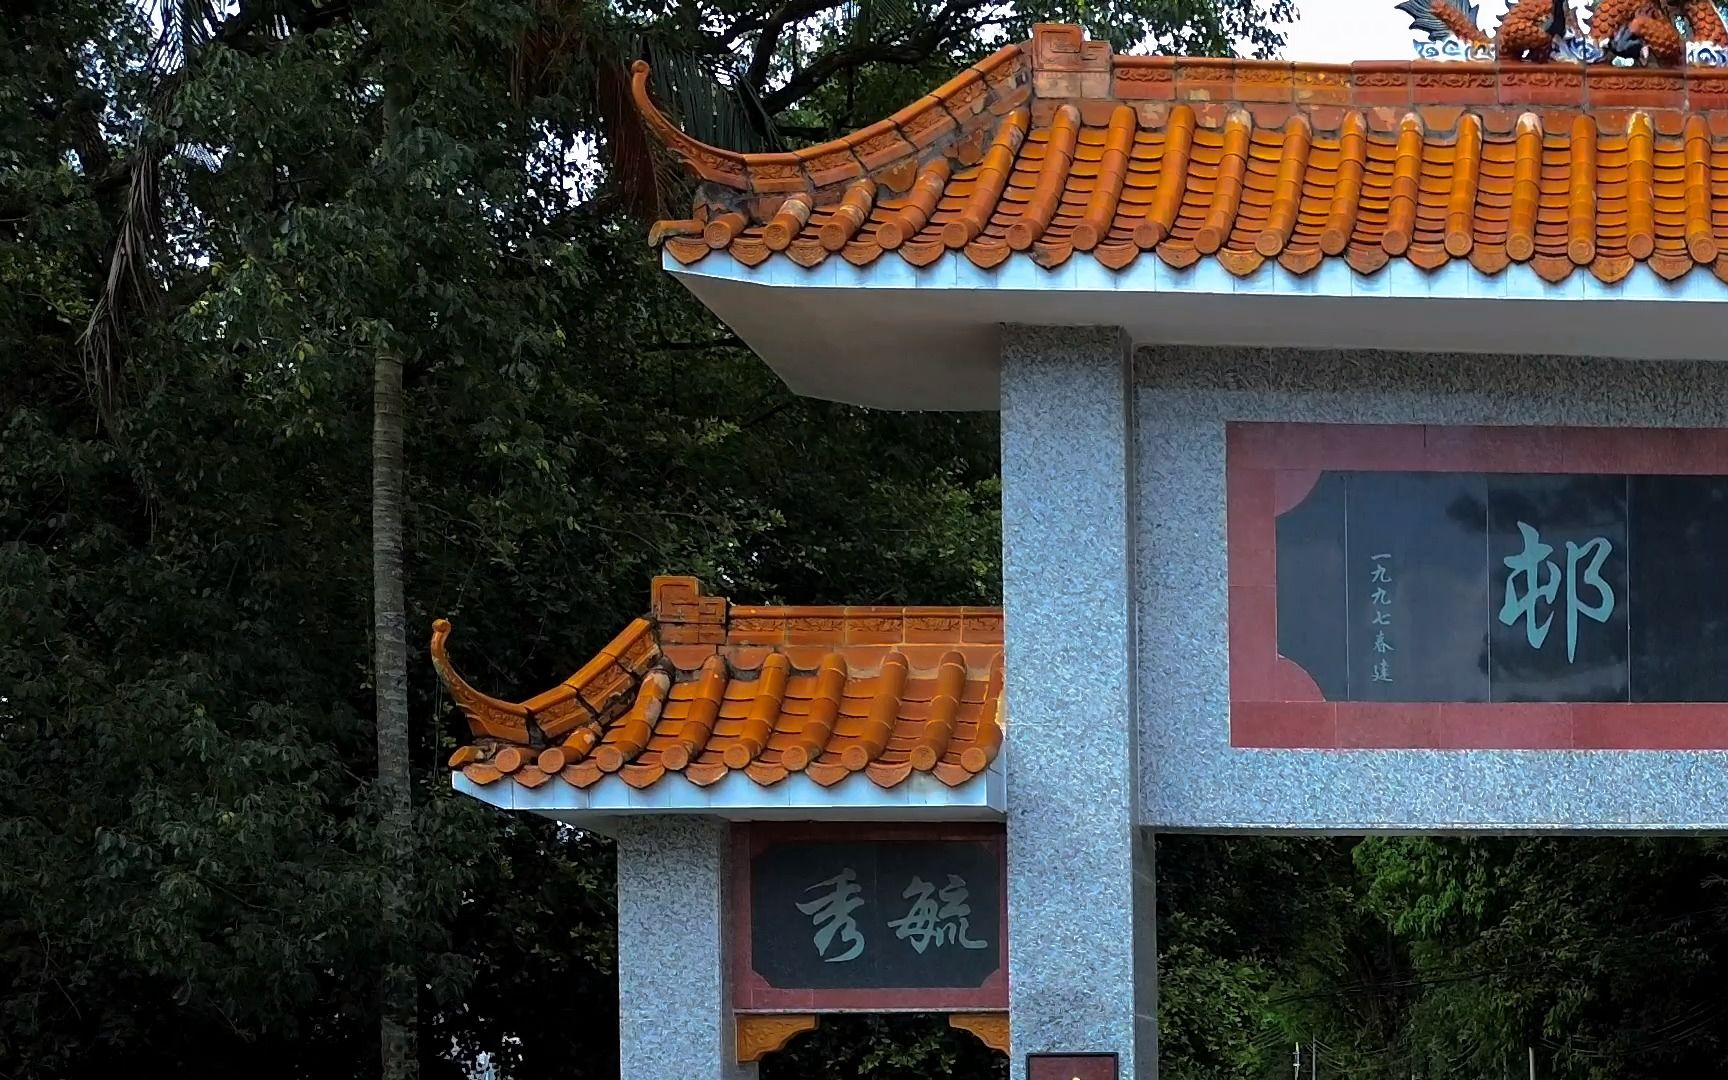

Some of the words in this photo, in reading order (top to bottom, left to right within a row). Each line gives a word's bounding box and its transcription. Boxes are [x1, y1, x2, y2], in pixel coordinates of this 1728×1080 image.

[1371, 553, 1395, 682] 一九九七春建
[795, 867, 988, 962] 毓秀
